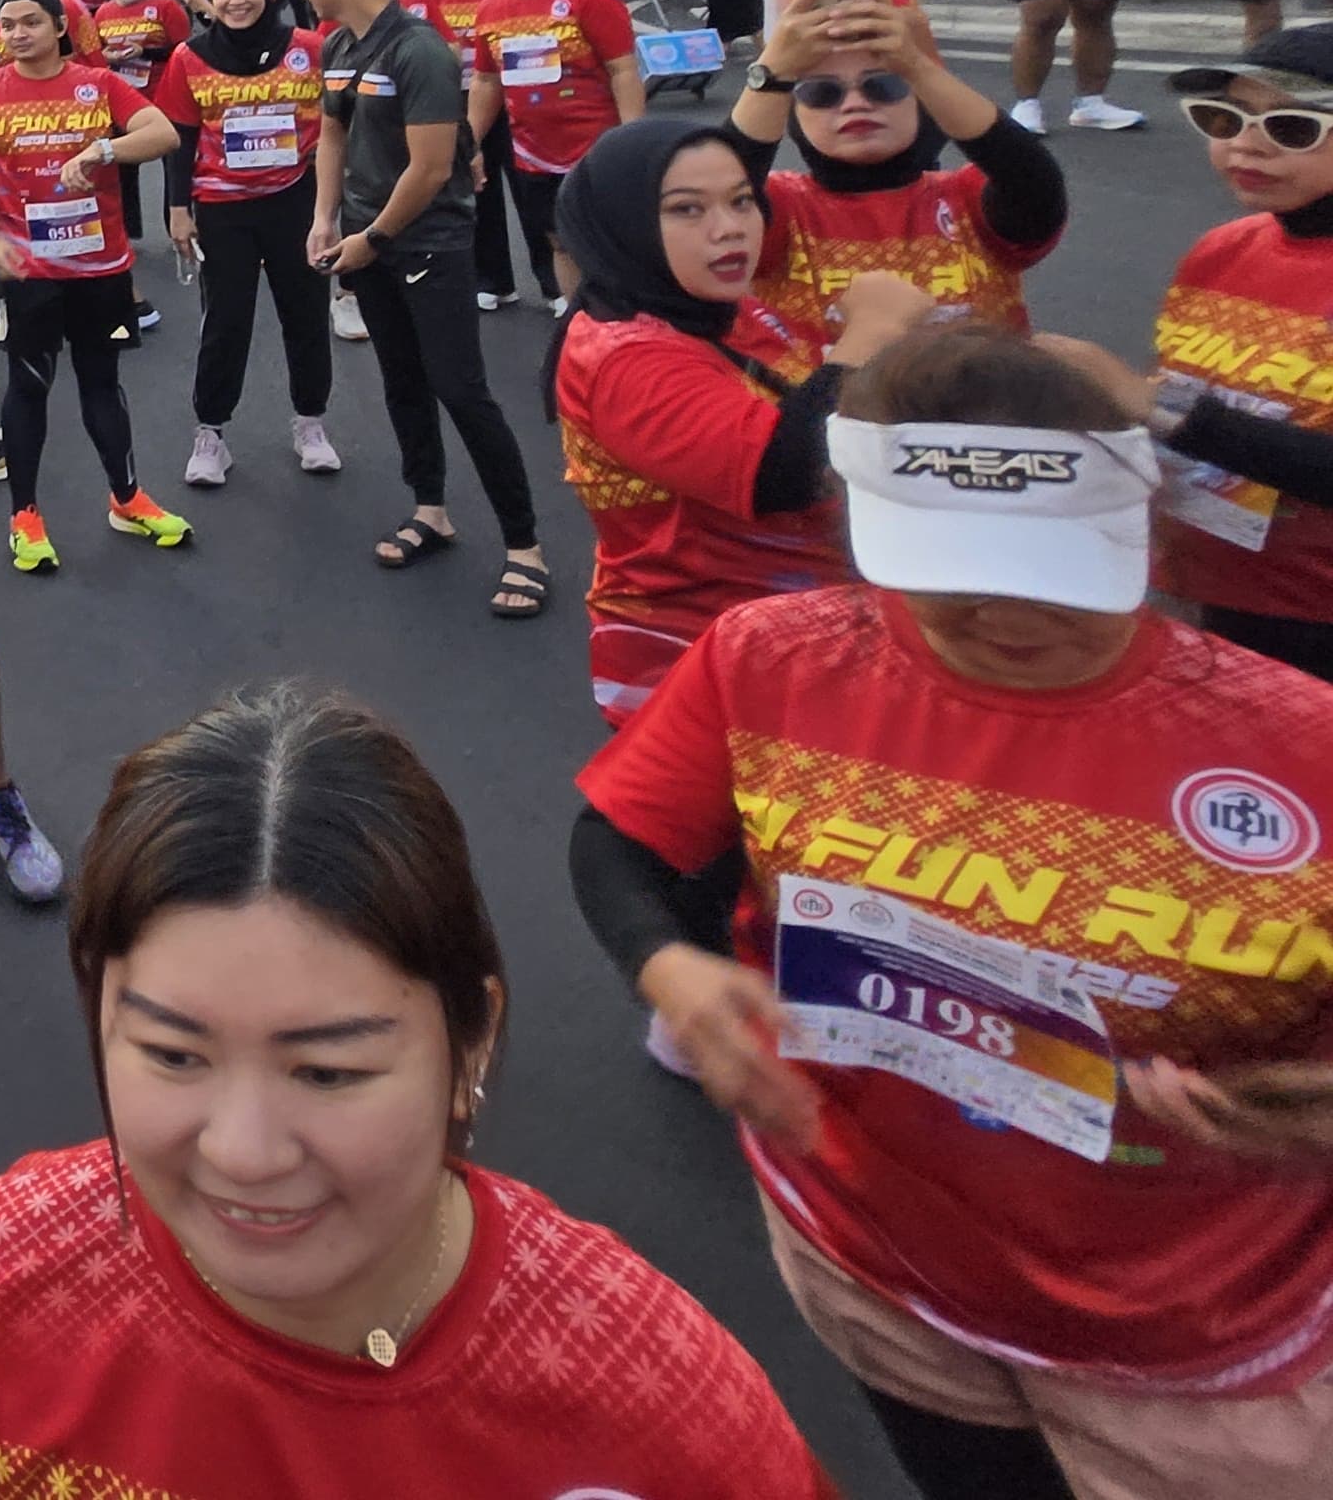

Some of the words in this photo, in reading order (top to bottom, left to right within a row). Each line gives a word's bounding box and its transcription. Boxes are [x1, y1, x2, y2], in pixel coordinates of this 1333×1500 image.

[217, 83, 271, 103] FUN
[276, 80, 322, 101] RUN
[10, 114, 62, 134] FUN
[66, 109, 112, 130] RUN
[243, 137, 278, 151] 0163
[47, 225, 83, 241] 0515
[905, 447, 1074, 480] AHEAD
[953, 473, 1023, 488] GOLF
[802, 819, 1066, 926] FUN
[1083, 887, 1333, 983] RUN
[857, 973, 1016, 1058] 0198
